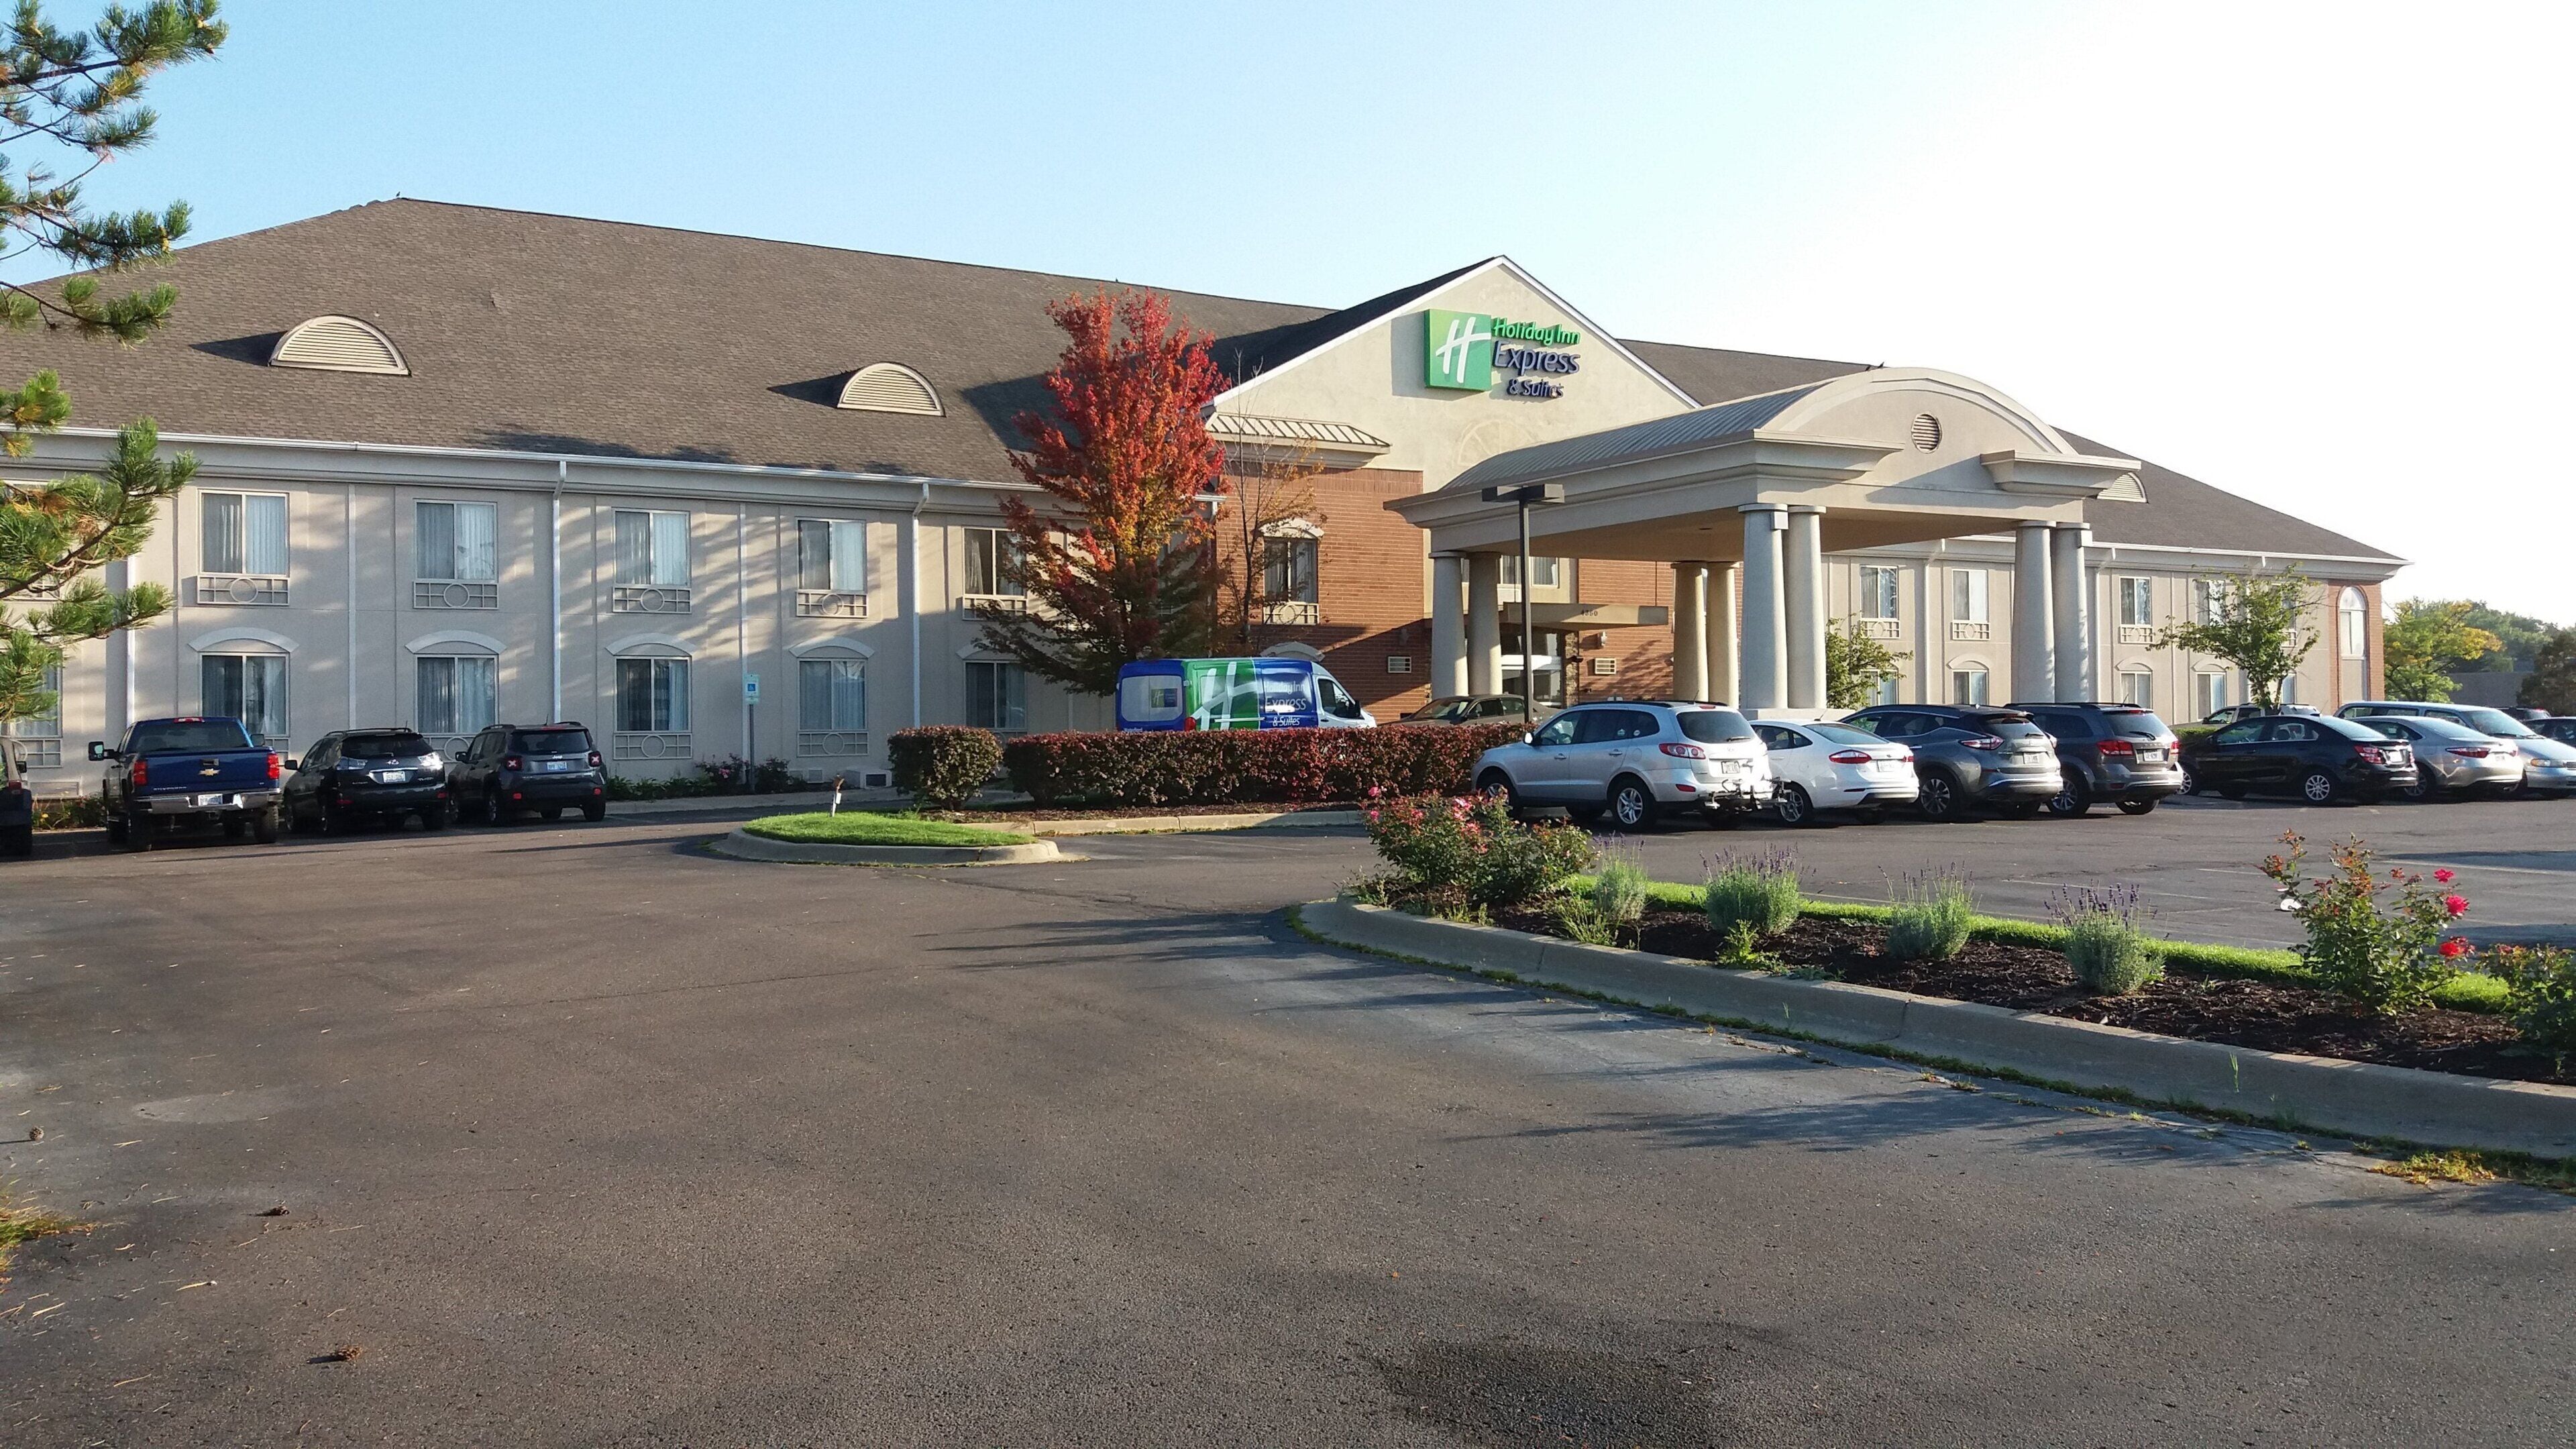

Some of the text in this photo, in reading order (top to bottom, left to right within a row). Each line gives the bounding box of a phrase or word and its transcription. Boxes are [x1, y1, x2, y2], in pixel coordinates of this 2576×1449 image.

[1493, 317, 1580, 346] Holiday Inn
[1493, 340, 1580, 376] Express
[1508, 378, 1564, 398] & Suites
[1264, 681, 1304, 694] Holiday Inn
[1265, 696, 1306, 716] Express
[1273, 716, 1300, 727] & Suites
